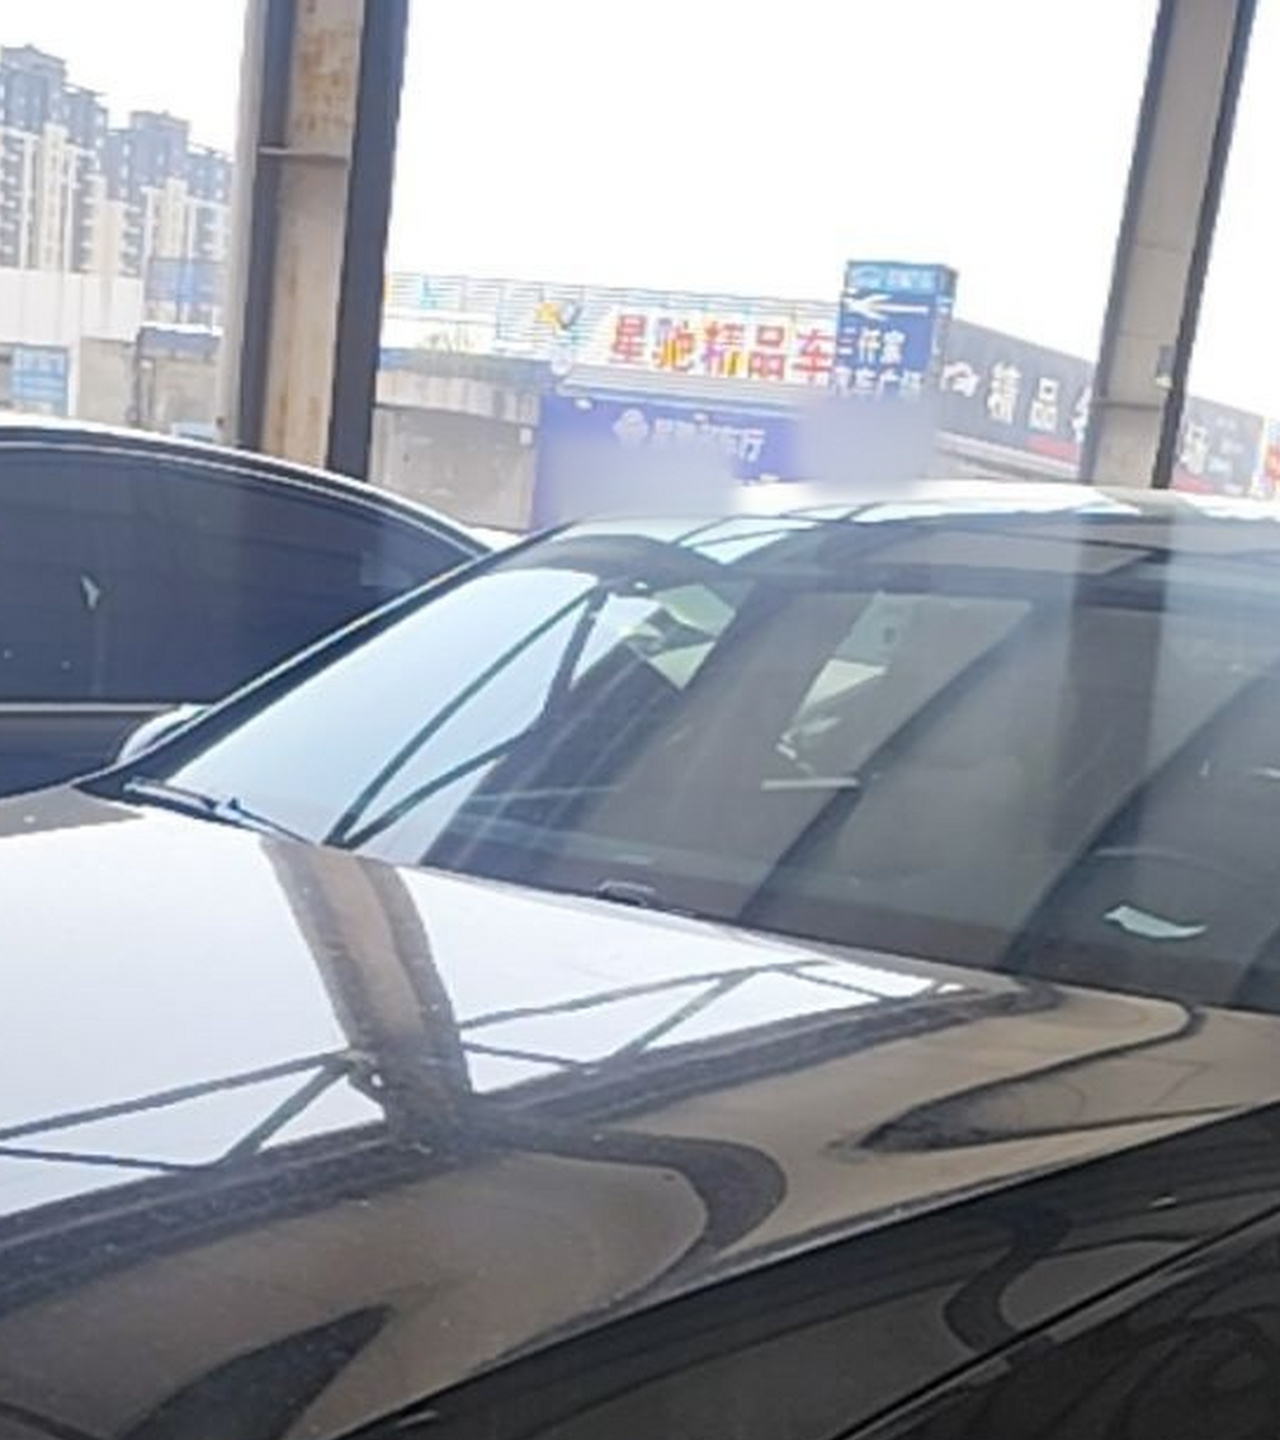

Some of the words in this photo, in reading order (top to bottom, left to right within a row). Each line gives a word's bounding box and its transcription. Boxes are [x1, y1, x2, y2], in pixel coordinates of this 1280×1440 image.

[610, 313, 834, 384] 星驰精品车
